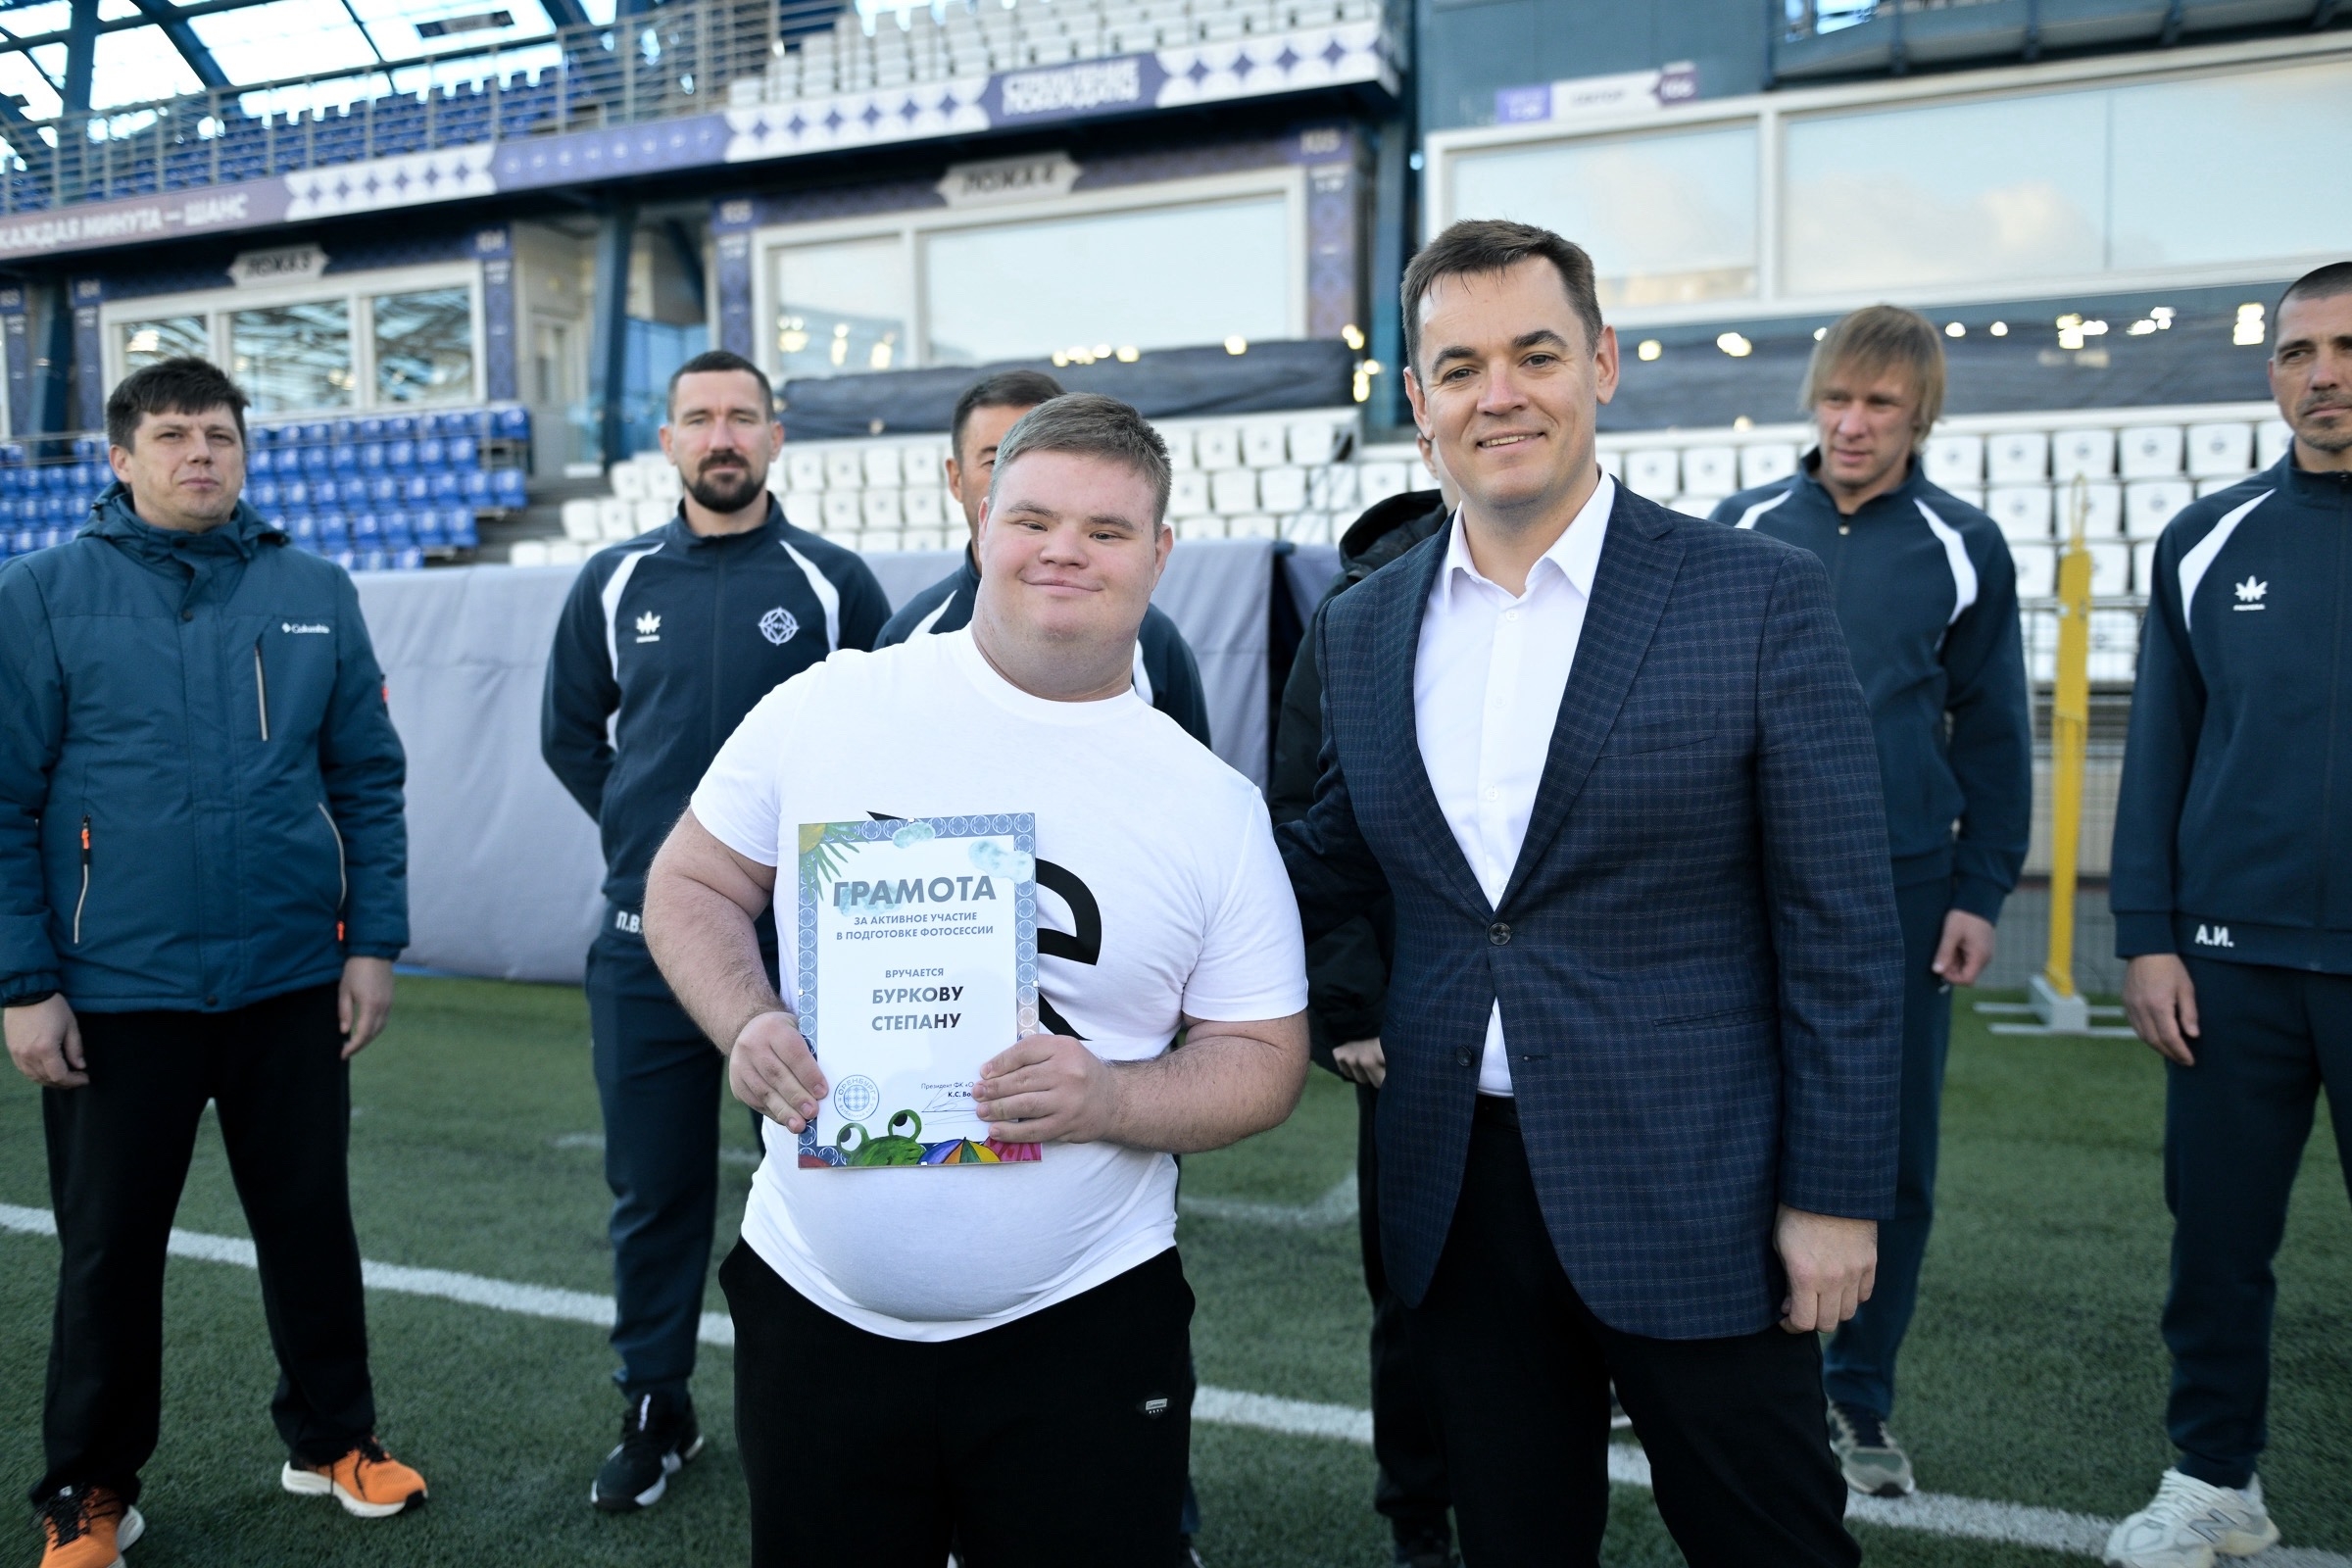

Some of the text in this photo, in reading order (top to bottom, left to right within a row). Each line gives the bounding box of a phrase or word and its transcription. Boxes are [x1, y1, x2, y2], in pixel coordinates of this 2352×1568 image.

[82, 206, 163, 237] МИНУТА
[184, 193, 249, 226] ШАНС
[832, 874, 997, 907] ГРАМОТА
[854, 911, 978, 925] ЗА АКТИВНОЕ УЧАСТИЕ
[836, 925, 994, 941] В ПОДГОТОВКЕ ФОТОСЕССИИ
[2194, 923, 2235, 948] А.И.
[885, 967, 944, 979] ВРУЧАЕТСЯ
[872, 986, 964, 1004] БУРКОВУ
[871, 1012, 961, 1031] СТЕПАНУ
[838, 1077, 876, 1096] ОРЕНБУРГ
